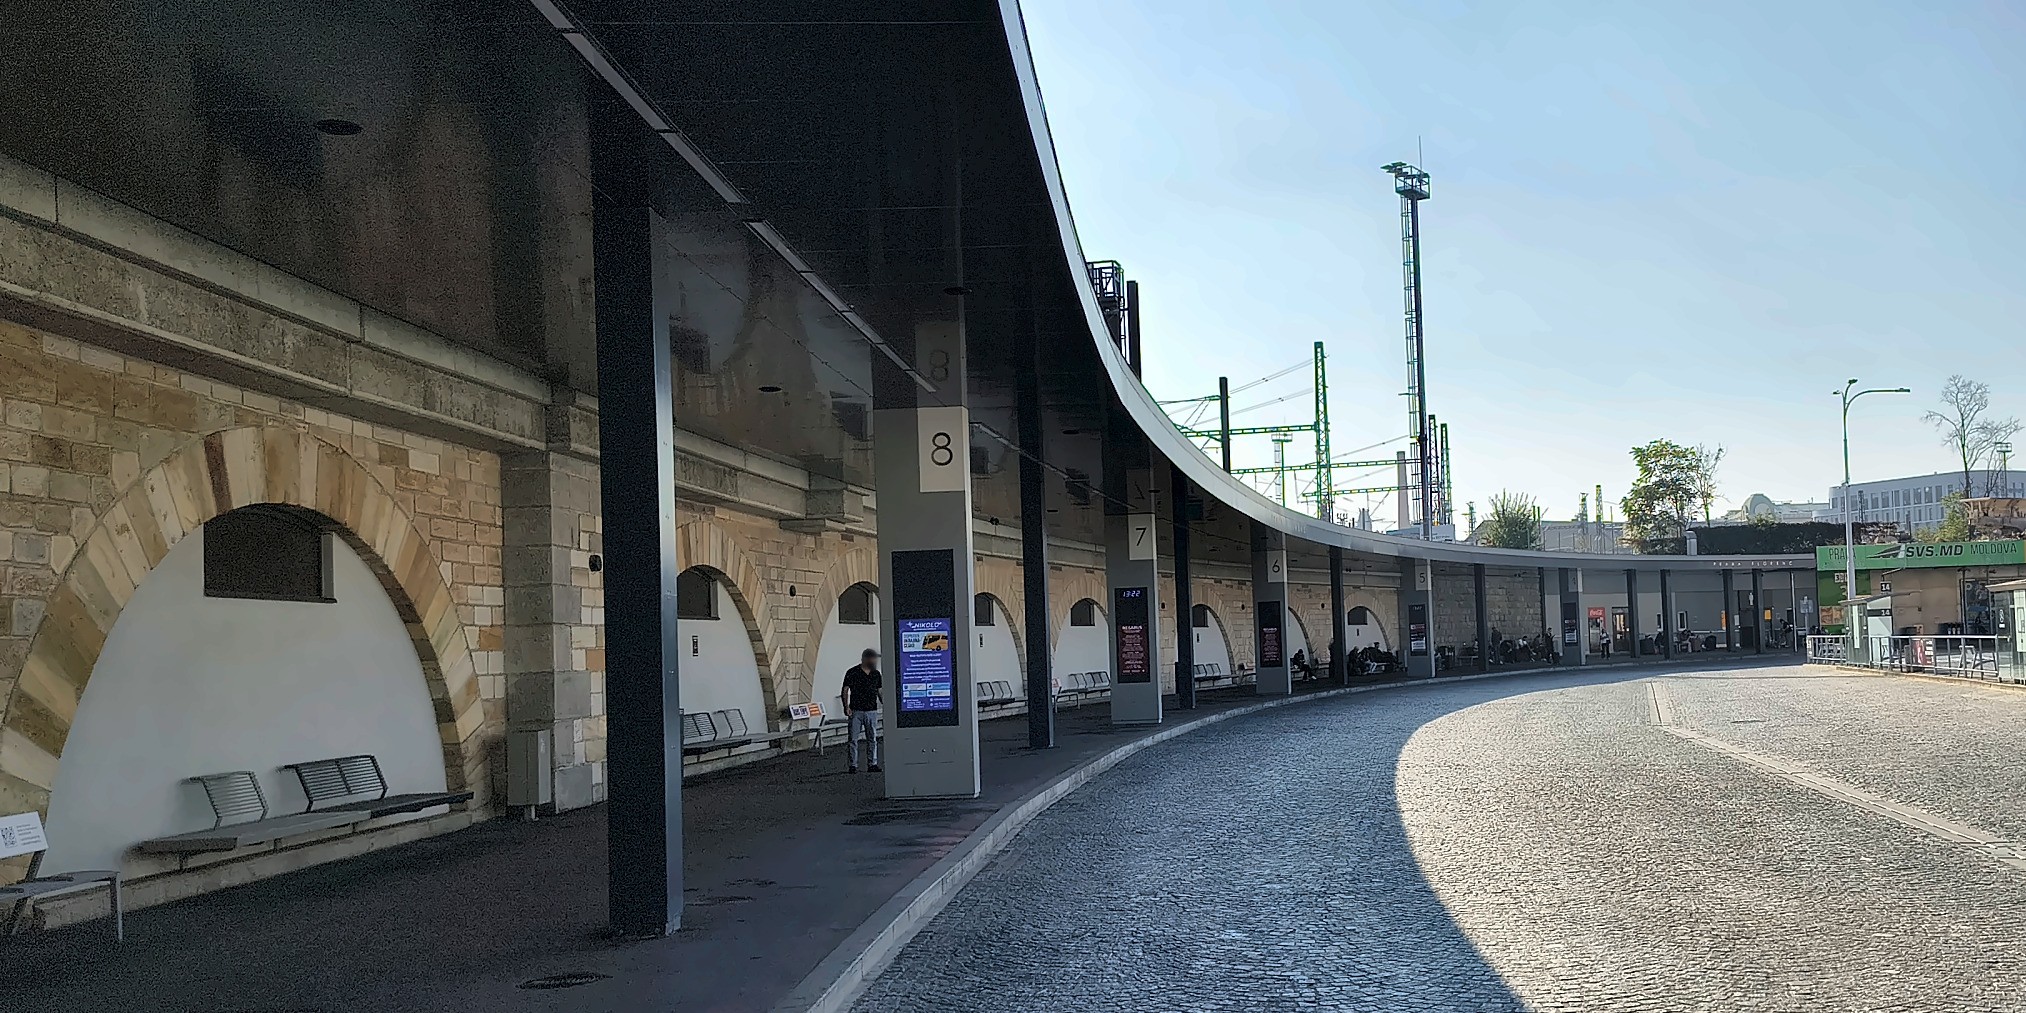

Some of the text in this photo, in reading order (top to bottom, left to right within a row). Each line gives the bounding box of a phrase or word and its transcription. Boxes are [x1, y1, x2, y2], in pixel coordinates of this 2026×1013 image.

[930, 431, 953, 467] 8
[1135, 527, 1147, 547] 7
[1828, 547, 1857, 560] PRAA
[1905, 544, 1964, 558] SVS.MD
[1970, 542, 2018, 555] MOLDOVA
[1271, 558, 1281, 573] 6
[1418, 571, 1427, 584] 5
[911, 621, 942, 629] NIKOLO
